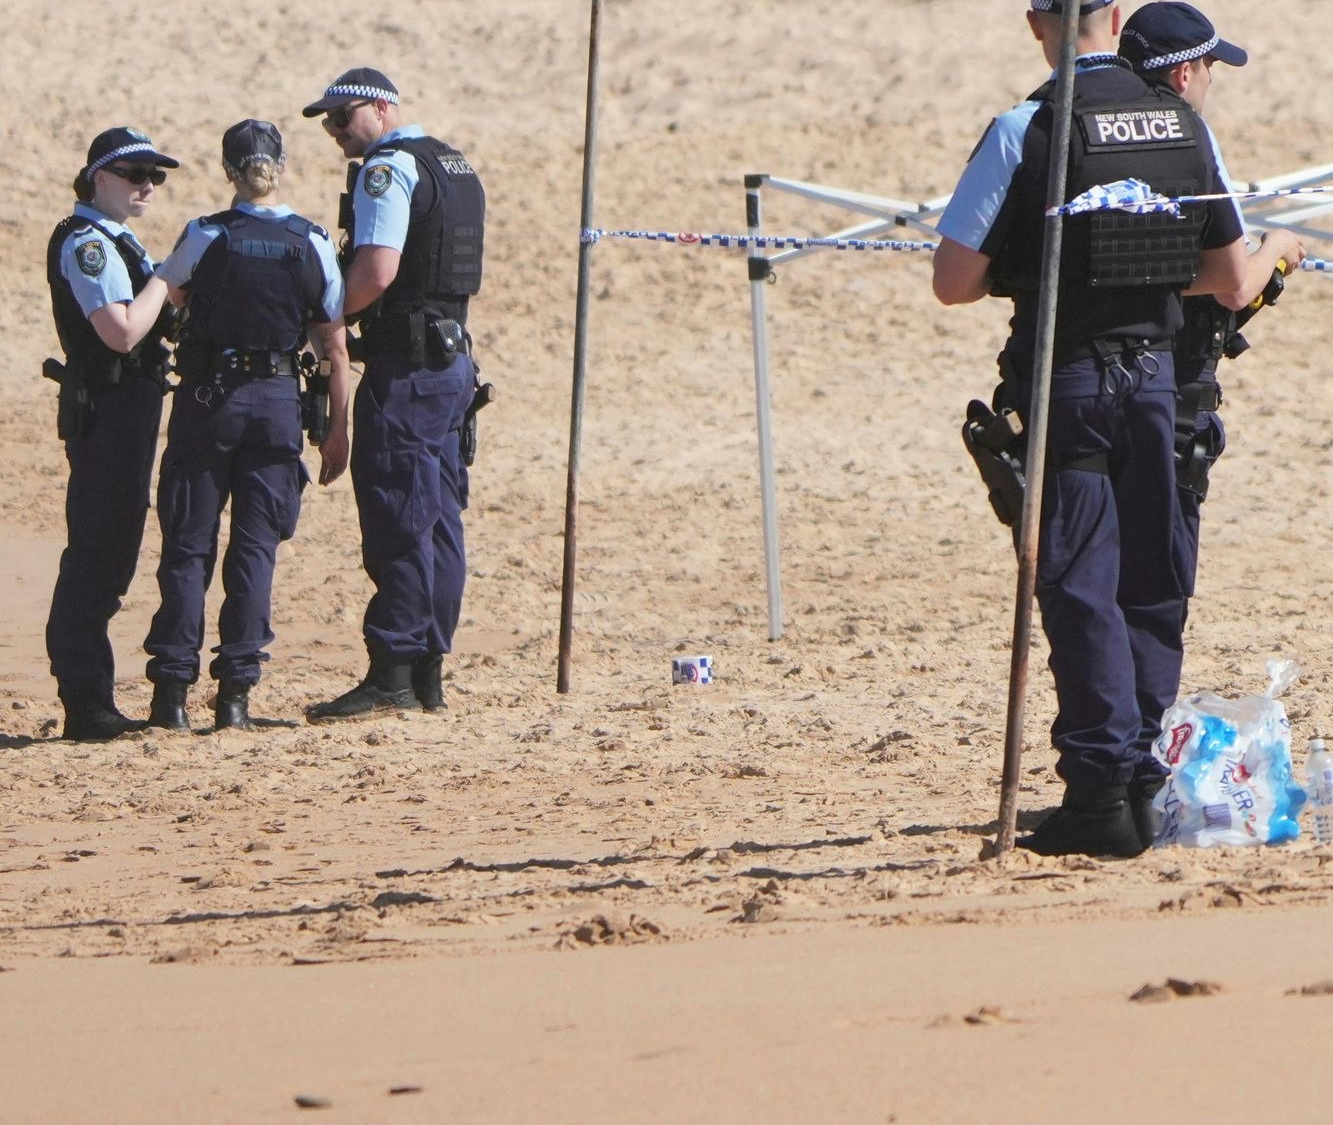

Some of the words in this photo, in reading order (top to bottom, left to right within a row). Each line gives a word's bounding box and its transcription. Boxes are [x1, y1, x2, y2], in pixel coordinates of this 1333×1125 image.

[1095, 114, 1116, 123] NEW
[1117, 112, 1146, 121] SOUTH
[1146, 110, 1177, 119] WALES
[1097, 118, 1184, 143] POLICE
